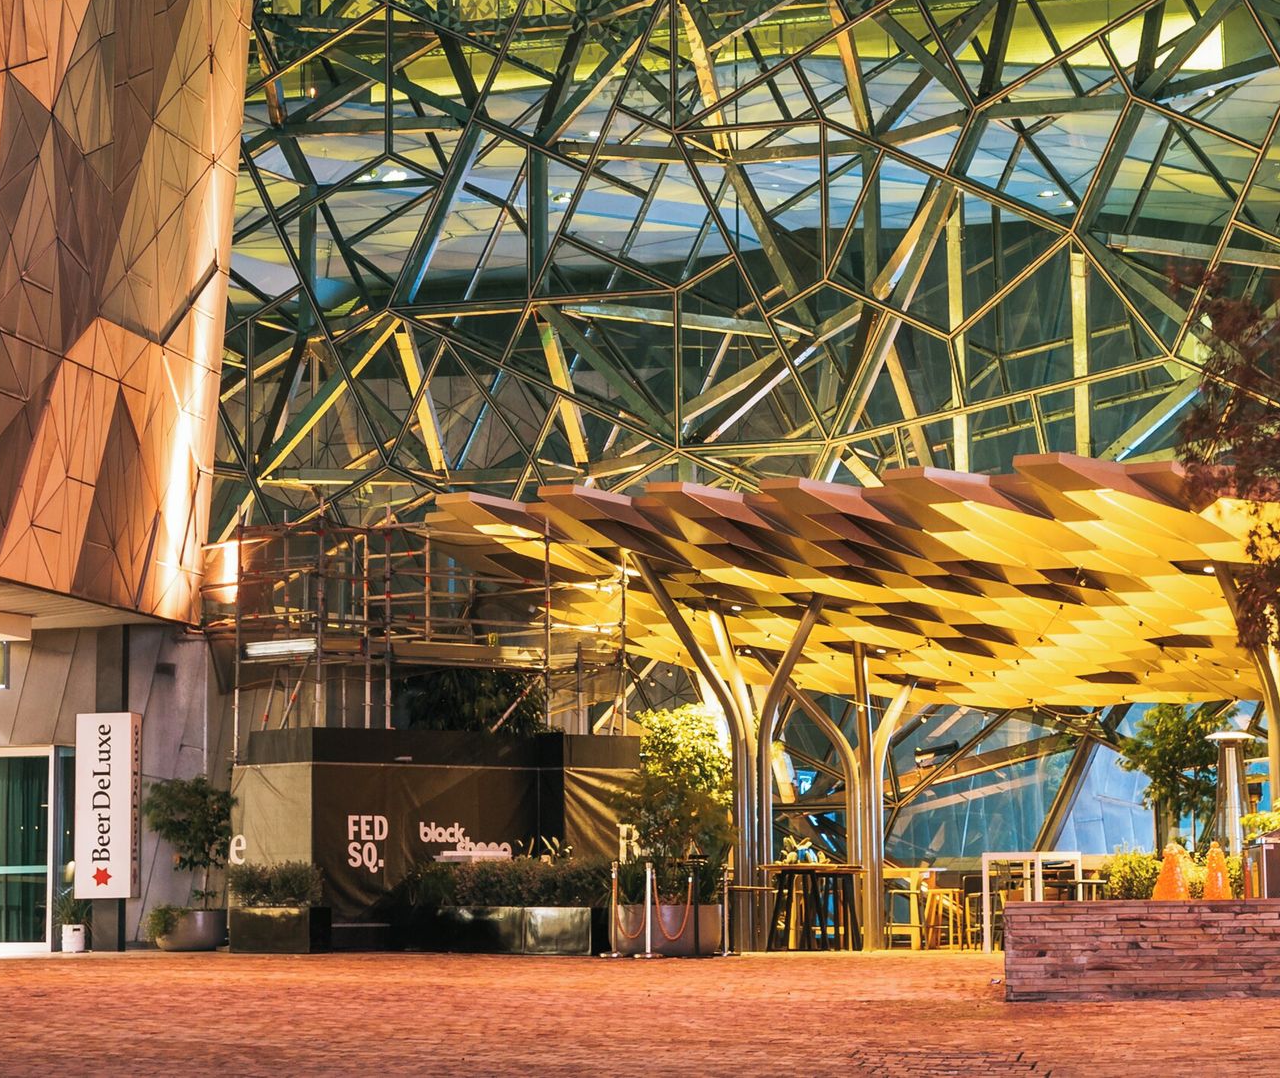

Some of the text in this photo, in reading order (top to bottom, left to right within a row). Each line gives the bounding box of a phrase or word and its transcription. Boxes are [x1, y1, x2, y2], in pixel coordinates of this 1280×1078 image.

[347, 815, 389, 841] FED
[419, 821, 466, 843] black
[347, 841, 384, 874] SQ.
